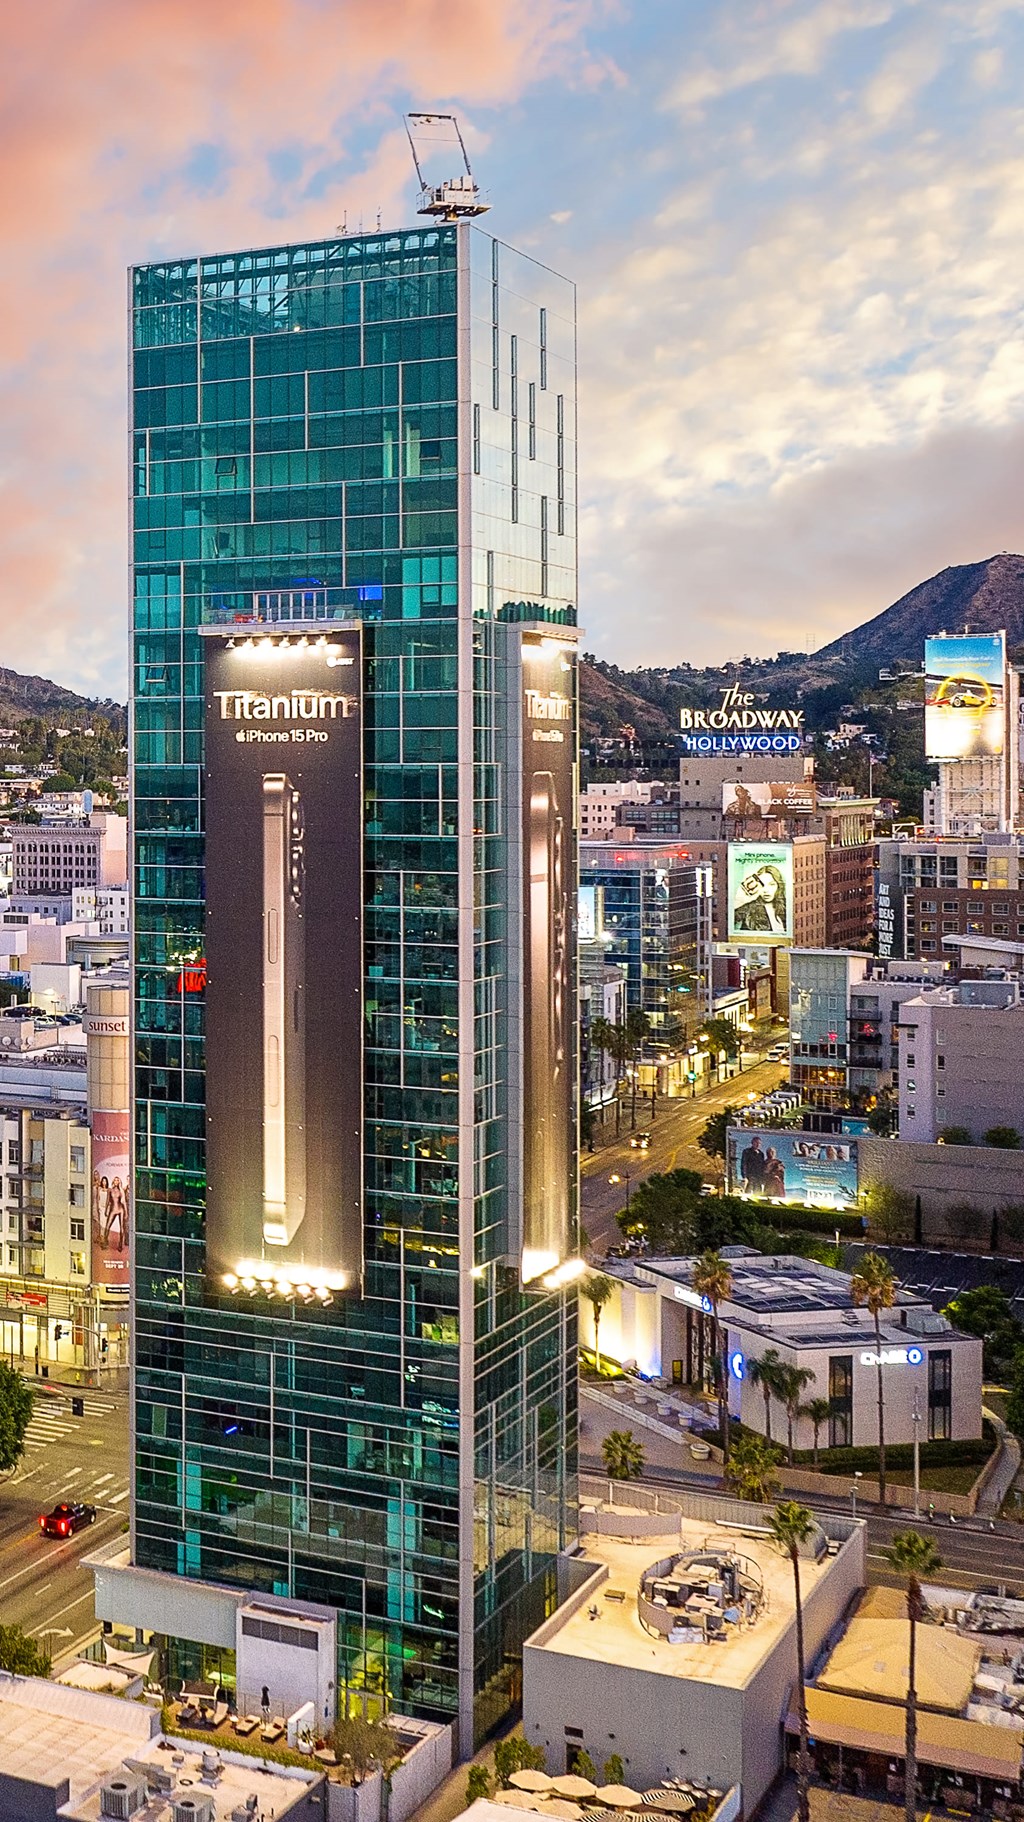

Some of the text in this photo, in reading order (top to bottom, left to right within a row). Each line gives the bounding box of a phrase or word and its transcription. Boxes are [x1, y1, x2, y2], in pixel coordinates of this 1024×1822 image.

[213, 690, 350, 719] Titanium
[719, 681, 755, 720] The
[680, 708, 805, 728] BROADWAY
[246, 729, 328, 742] iPhone 15 Pro
[686, 736, 800, 750] HOLLYWOOD
[879, 884, 889, 895] ART
[879, 907, 895, 920] IDEAS
[879, 920, 889, 932] FOR
[879, 931, 893, 944] MORE
[89, 1021, 126, 1032] sunset
